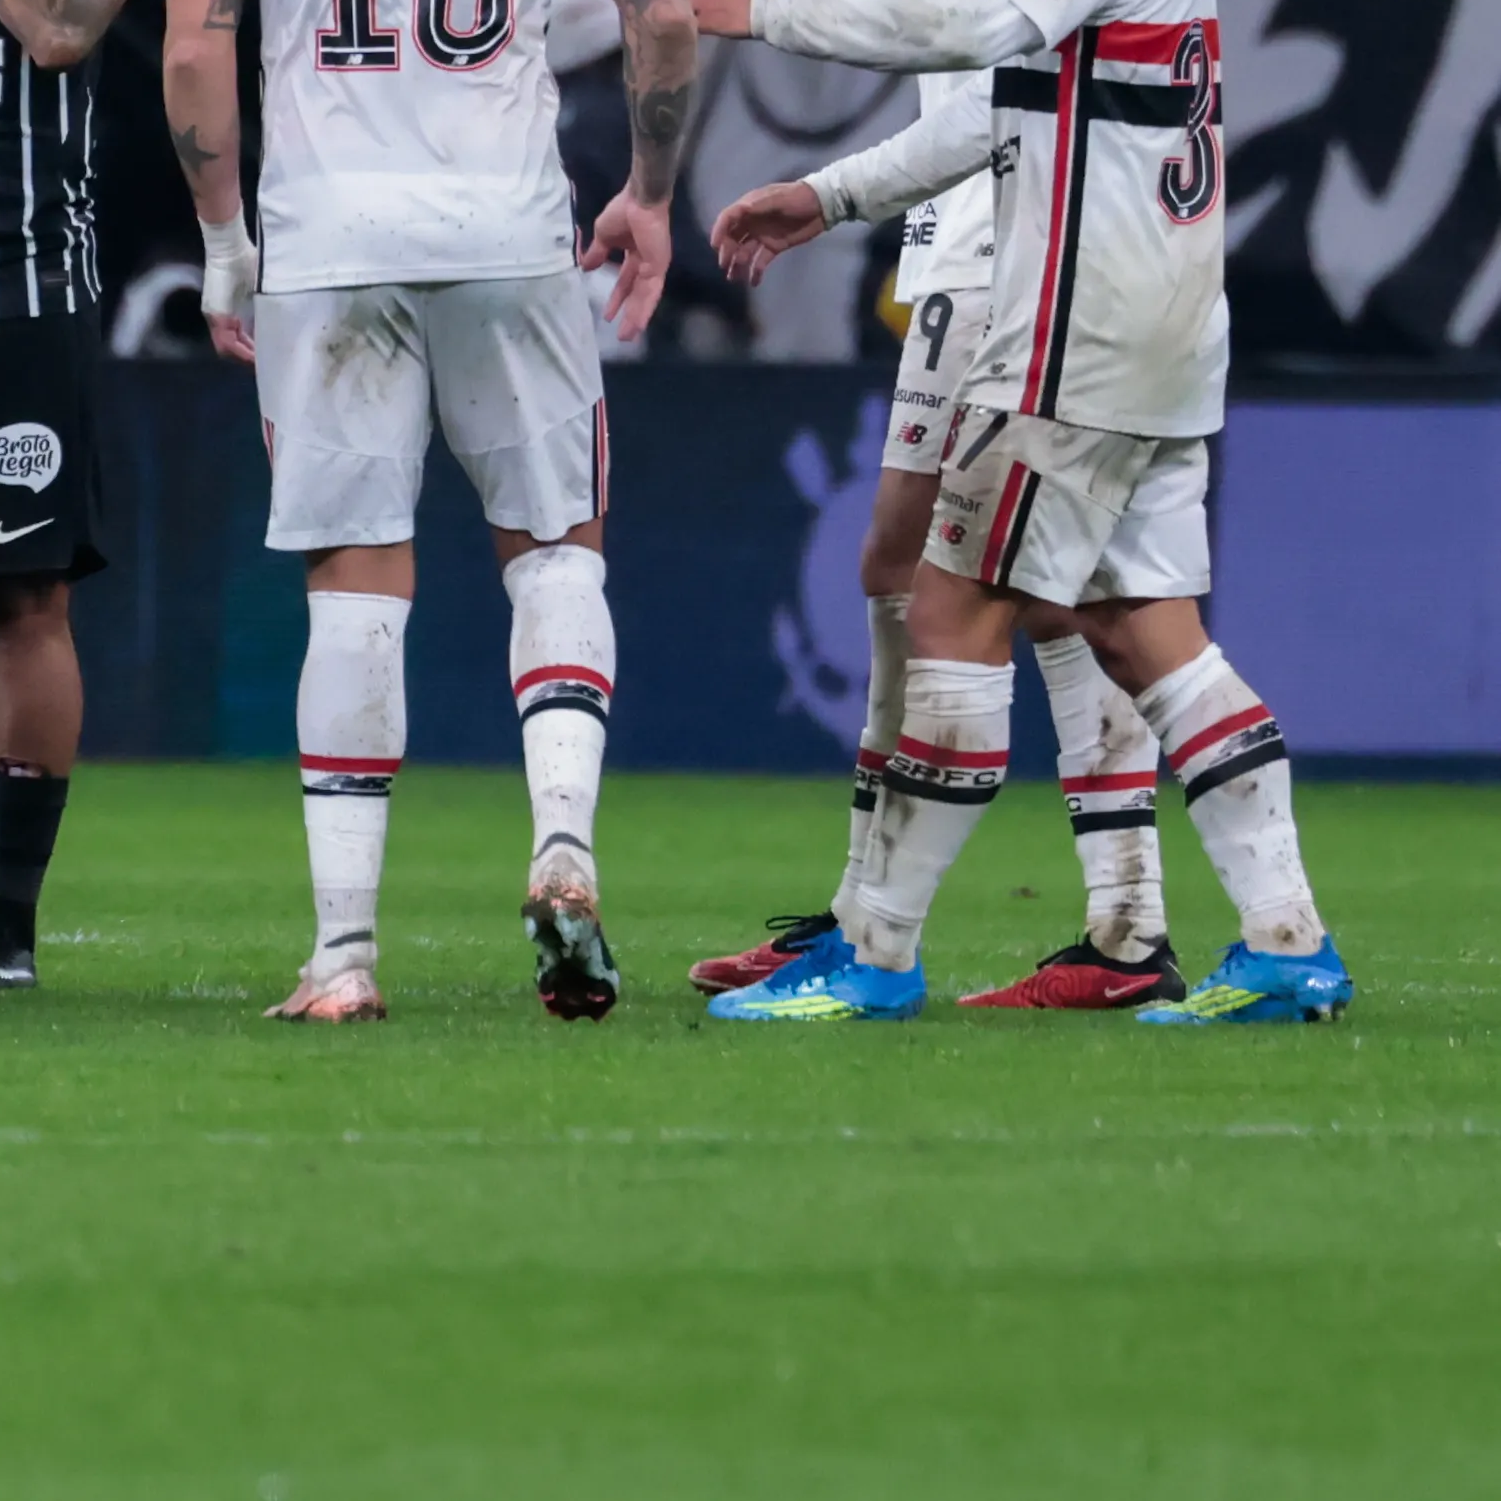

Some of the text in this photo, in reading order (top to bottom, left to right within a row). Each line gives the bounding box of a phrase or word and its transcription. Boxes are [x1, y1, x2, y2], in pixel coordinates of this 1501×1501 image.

[1157, 18, 1220, 226] 3
[920, 293, 954, 372] 9
[887, 755, 998, 786] SPFC
